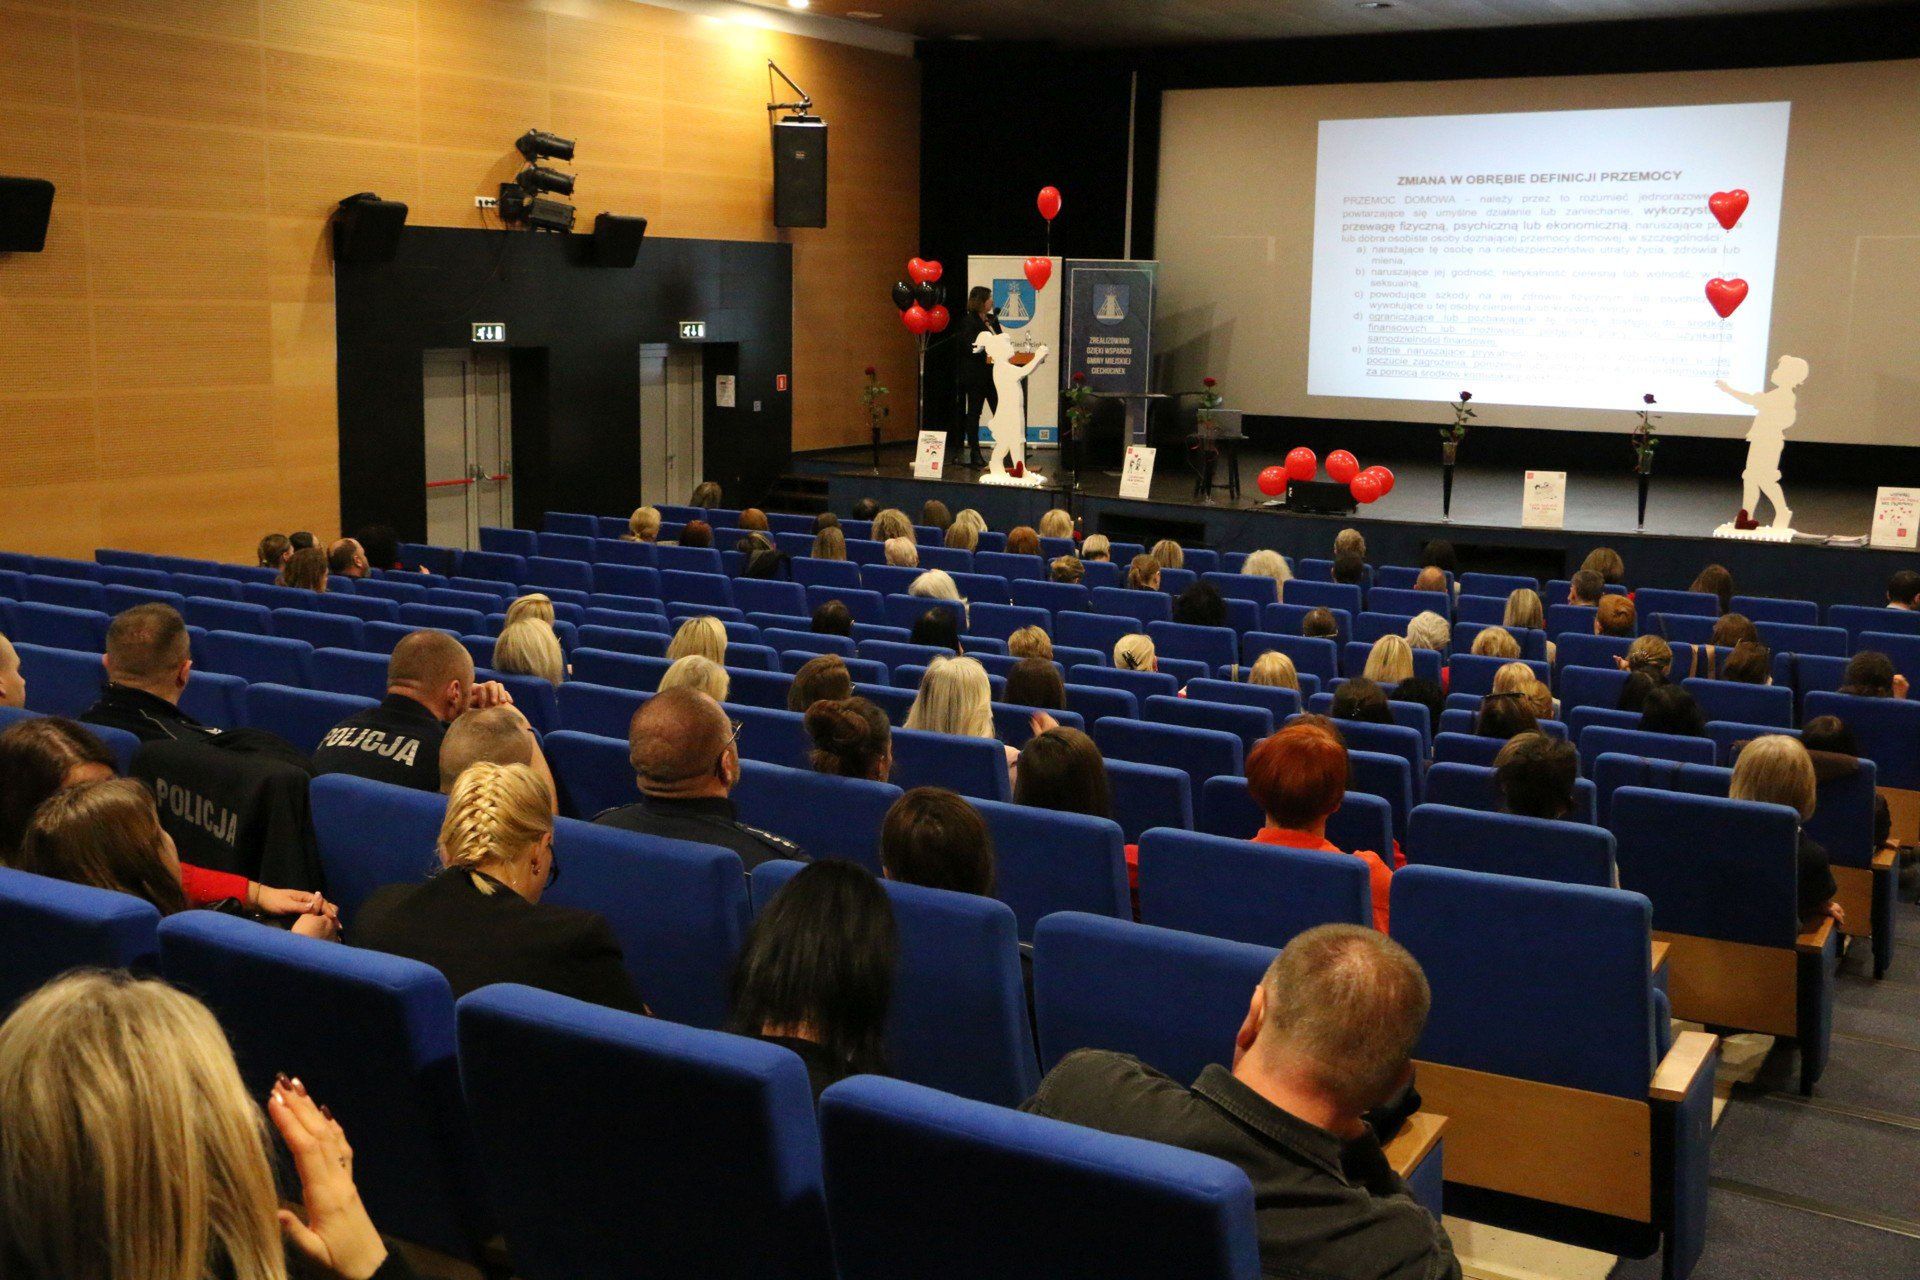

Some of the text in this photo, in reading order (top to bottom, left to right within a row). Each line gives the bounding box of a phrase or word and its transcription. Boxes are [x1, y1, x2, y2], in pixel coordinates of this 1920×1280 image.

[1396, 170, 1682, 186] ZMIANA W OBRĘBIE DEFINICJI PRZEMOCY
[1344, 196, 1396, 205] PRZEMOC
[1404, 196, 1456, 204] DOMOWA
[1522, 195, 1550, 204] przez
[1580, 193, 1628, 202] rozumieć
[1342, 209, 1404, 218] powtarzające
[1414, 208, 1427, 218] się
[1436, 208, 1476, 218] umyślne
[1486, 208, 1531, 216] działanie
[1541, 208, 1556, 216] lub
[1342, 222, 1396, 232] przewagę
[1400, 221, 1449, 232] fizyczną,
[1454, 221, 1518, 232] psychiczną
[1524, 221, 1541, 230] lub
[1546, 220, 1631, 232] ekonomiczną,
[1342, 234, 1356, 242] lub
[1358, 234, 1385, 242] dobra
[1388, 234, 1428, 242] osobiste
[1430, 234, 1460, 244] osoby
[1520, 235, 1570, 244] przemocy
[1356, 246, 1366, 254] a)
[1372, 257, 1406, 266] mienia,
[1355, 268, 1365, 277] b)
[1371, 268, 1429, 277] naruszające
[1354, 291, 1364, 299] c)
[1370, 291, 1426, 300] powodujące
[1370, 302, 1424, 312] wywołujące
[1353, 312, 1363, 320] d)
[1352, 346, 1361, 354] e)
[1366, 368, 1377, 376] za
[318, 727, 420, 767] POLICJA
[156, 778, 238, 847] POLICJA
